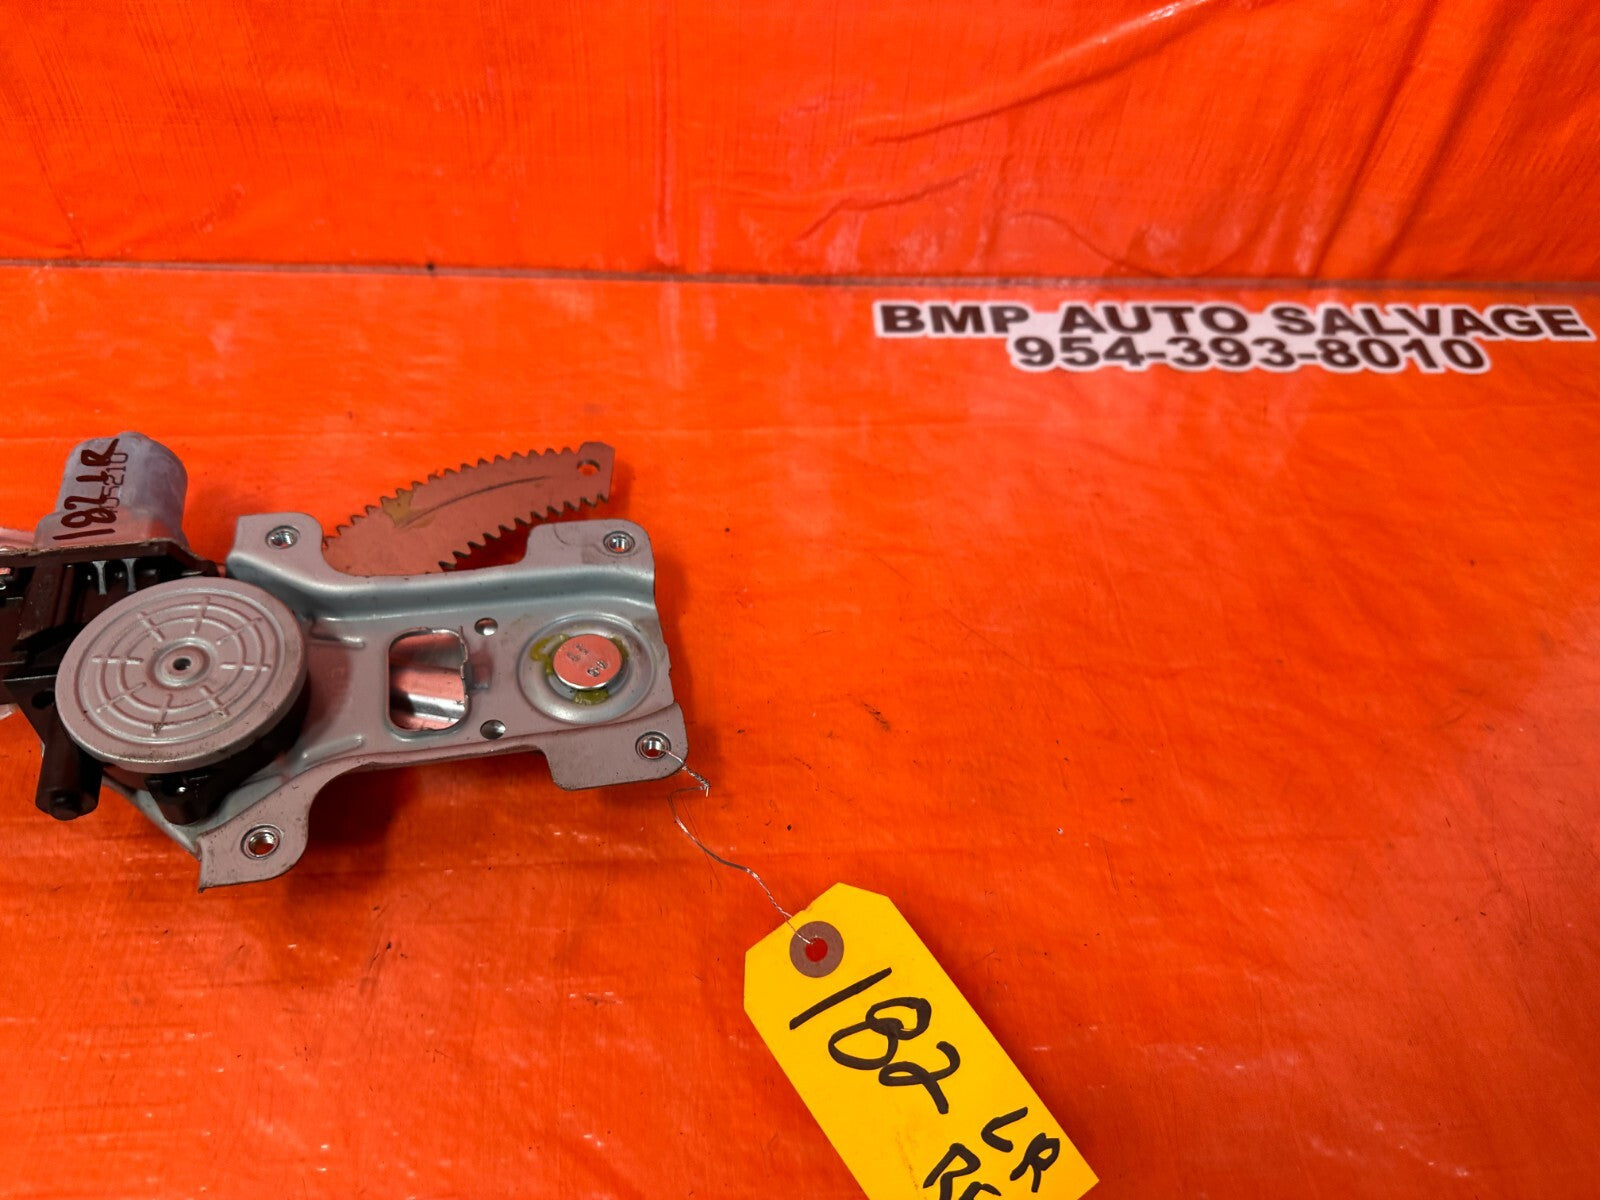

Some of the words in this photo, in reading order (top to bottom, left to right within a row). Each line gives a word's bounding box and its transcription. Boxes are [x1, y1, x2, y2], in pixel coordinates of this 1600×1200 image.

[880, 304, 1030, 334] BMP
[1059, 305, 1249, 335] AUTO
[1270, 306, 1592, 337] SALVAGE
[1013, 336, 1485, 369] 954-393-8010
[76, 438, 119, 482] LR
[52, 495, 118, 540] 182
[789, 967, 961, 1114] 182
[981, 1107, 1060, 1193] LR
